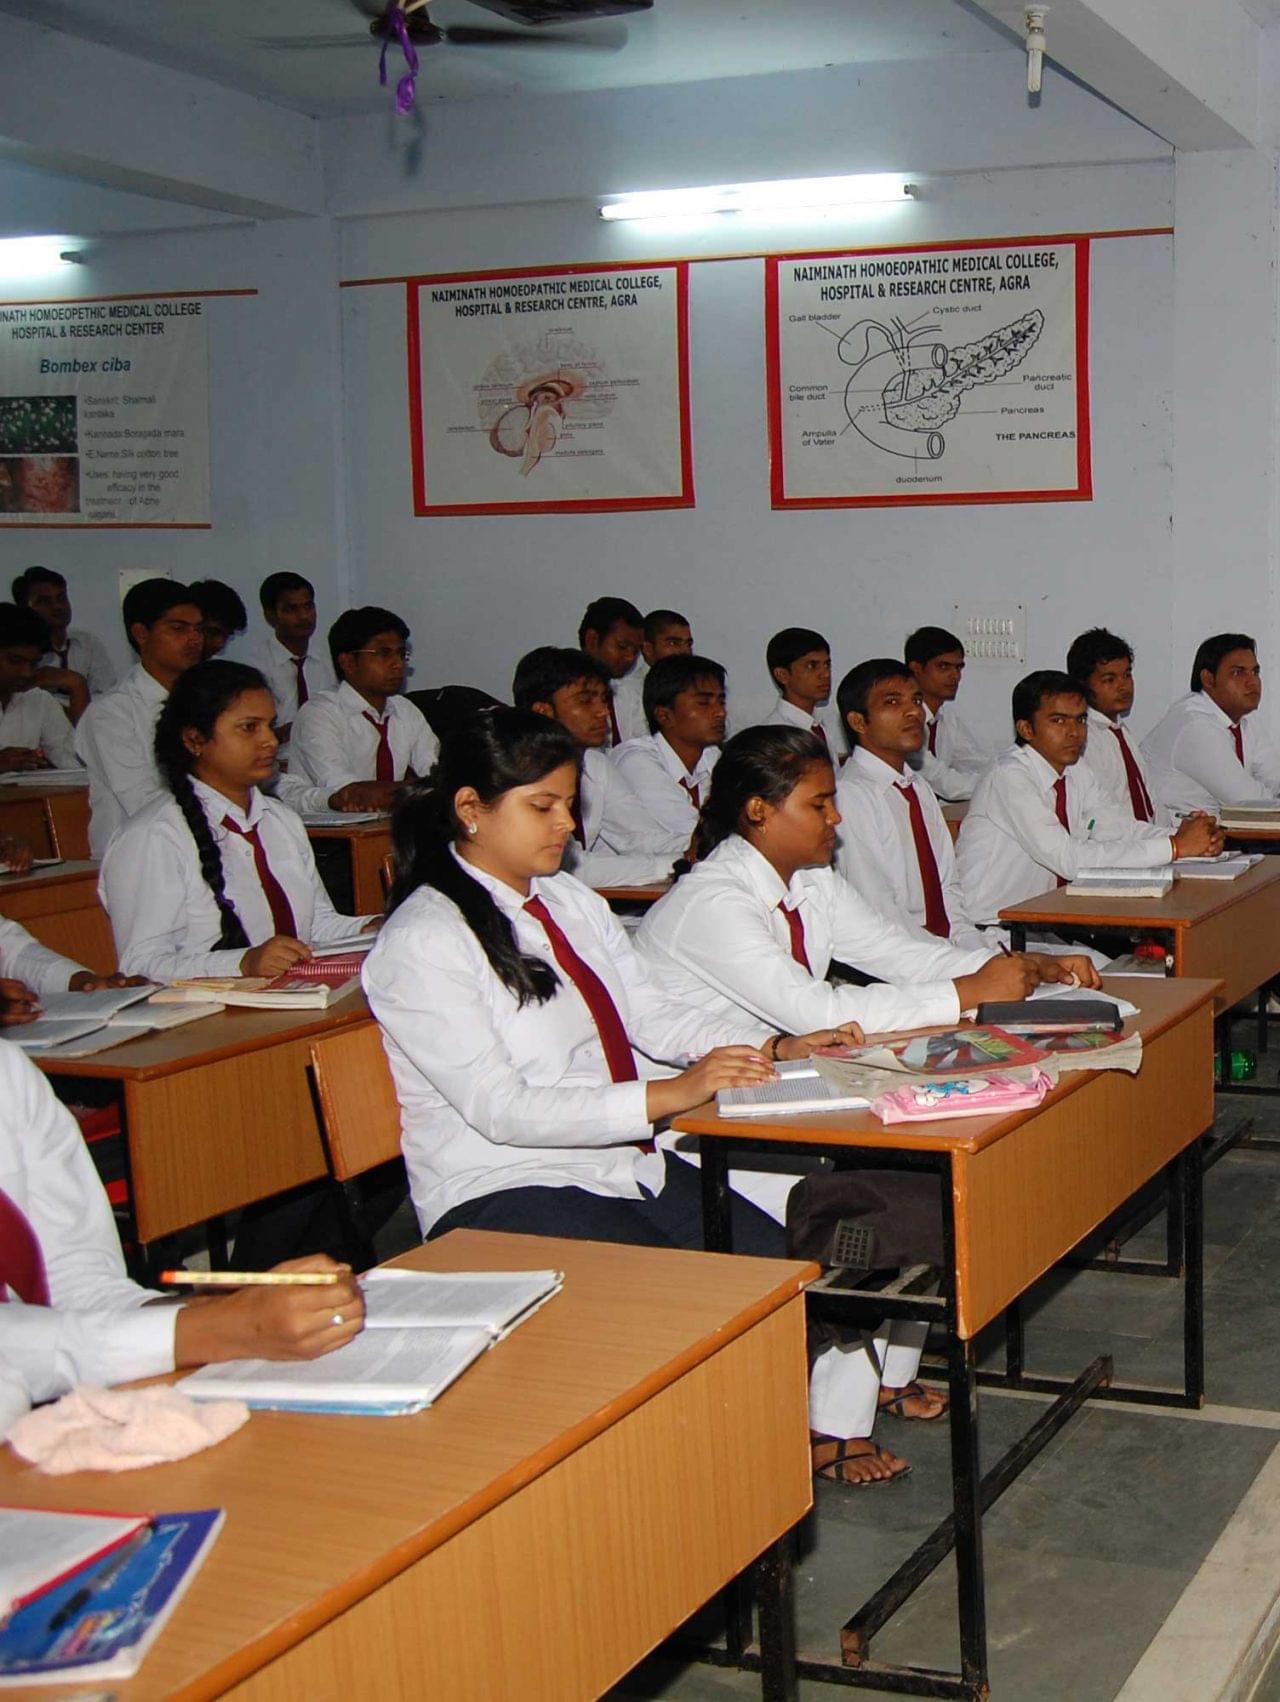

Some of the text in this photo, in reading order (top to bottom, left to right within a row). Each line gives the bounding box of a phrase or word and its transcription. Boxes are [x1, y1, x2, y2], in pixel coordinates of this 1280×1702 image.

[794, 252, 1059, 282] NAIMINATH HOMOEOPATHIC MEDICAL COLLEGE,
[431, 276, 662, 303] NAIMINATH HOMOEOPATHIC MEDICAL COLLEGE,
[820, 274, 1031, 301] HOSPITAL & RESEARCH CENTRE, AGRA
[455, 293, 638, 318] HOSPITAL & RESEARCH CENTRE, AGRA
[962, 303, 982, 313] duct
[30, 306, 106, 321] HOMOEOPETHIC
[109, 304, 152, 319] MEDICAL
[154, 302, 202, 317] COLLEGE
[808, 312, 841, 322] bladder
[11, 321, 165, 340] HOSPITAL & RESEARCH CENTER
[40, 356, 131, 374] Bombex ciba
[1023, 373, 1071, 382] Pancreatic
[789, 384, 829, 393] Common
[1034, 382, 1055, 391] duct
[807, 391, 826, 401] duct
[1001, 405, 1045, 415] Pancreas
[995, 430, 1076, 441] THE PANCREAS
[802, 438, 812, 447] of
[895, 474, 943, 484] duodenum
